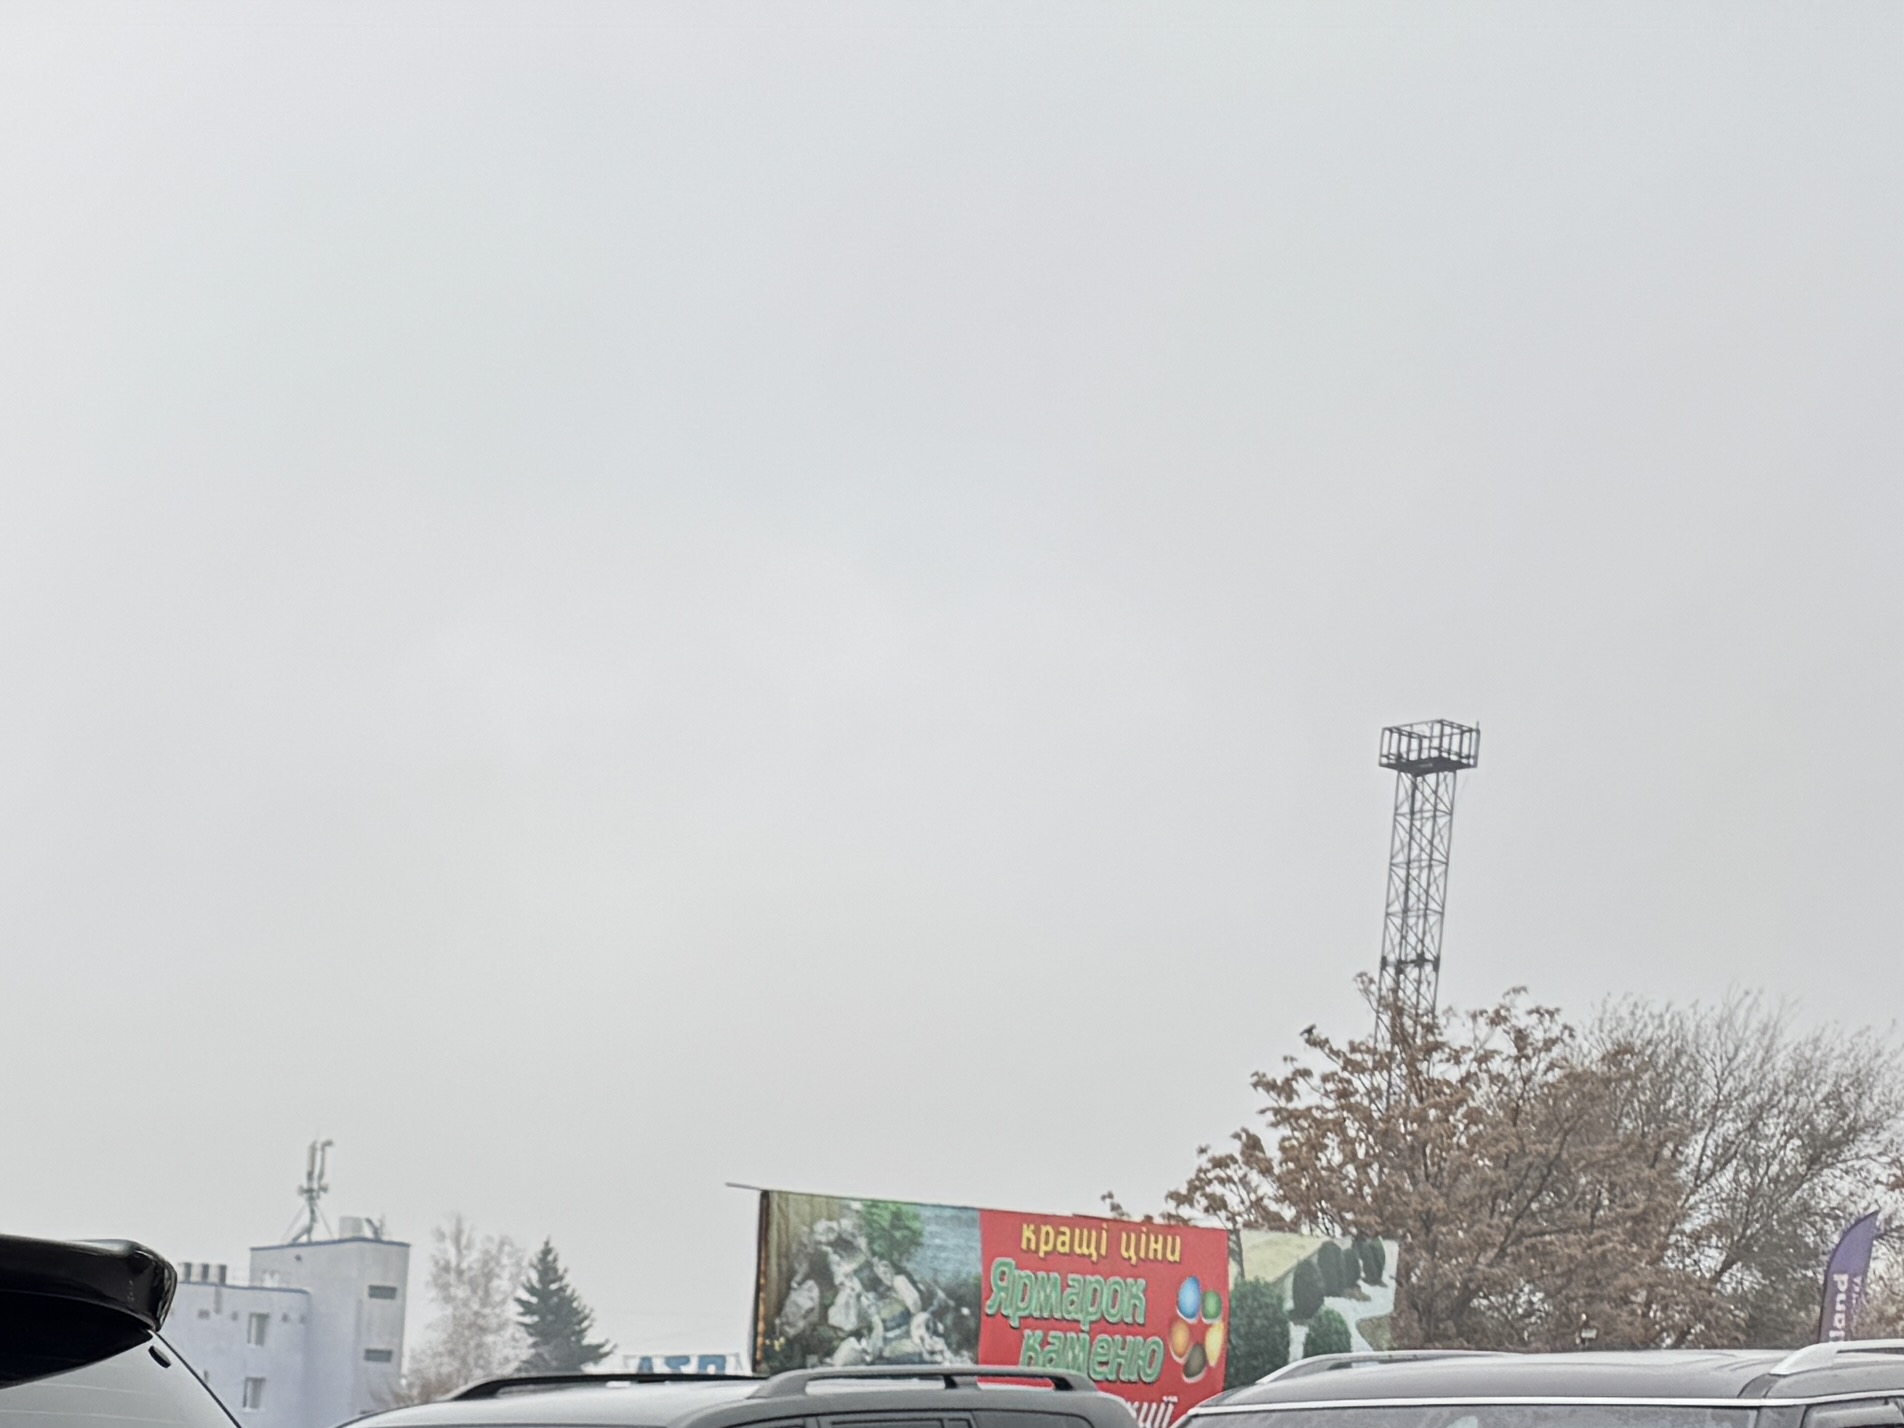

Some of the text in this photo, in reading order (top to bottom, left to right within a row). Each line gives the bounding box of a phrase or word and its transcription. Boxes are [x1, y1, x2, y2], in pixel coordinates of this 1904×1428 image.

[1020, 1222, 1181, 1266] кращі ціни
[985, 1256, 1147, 1332] Ярмарок
[1828, 1273, 1849, 1340] land
[1019, 1328, 1165, 1384] каменю
